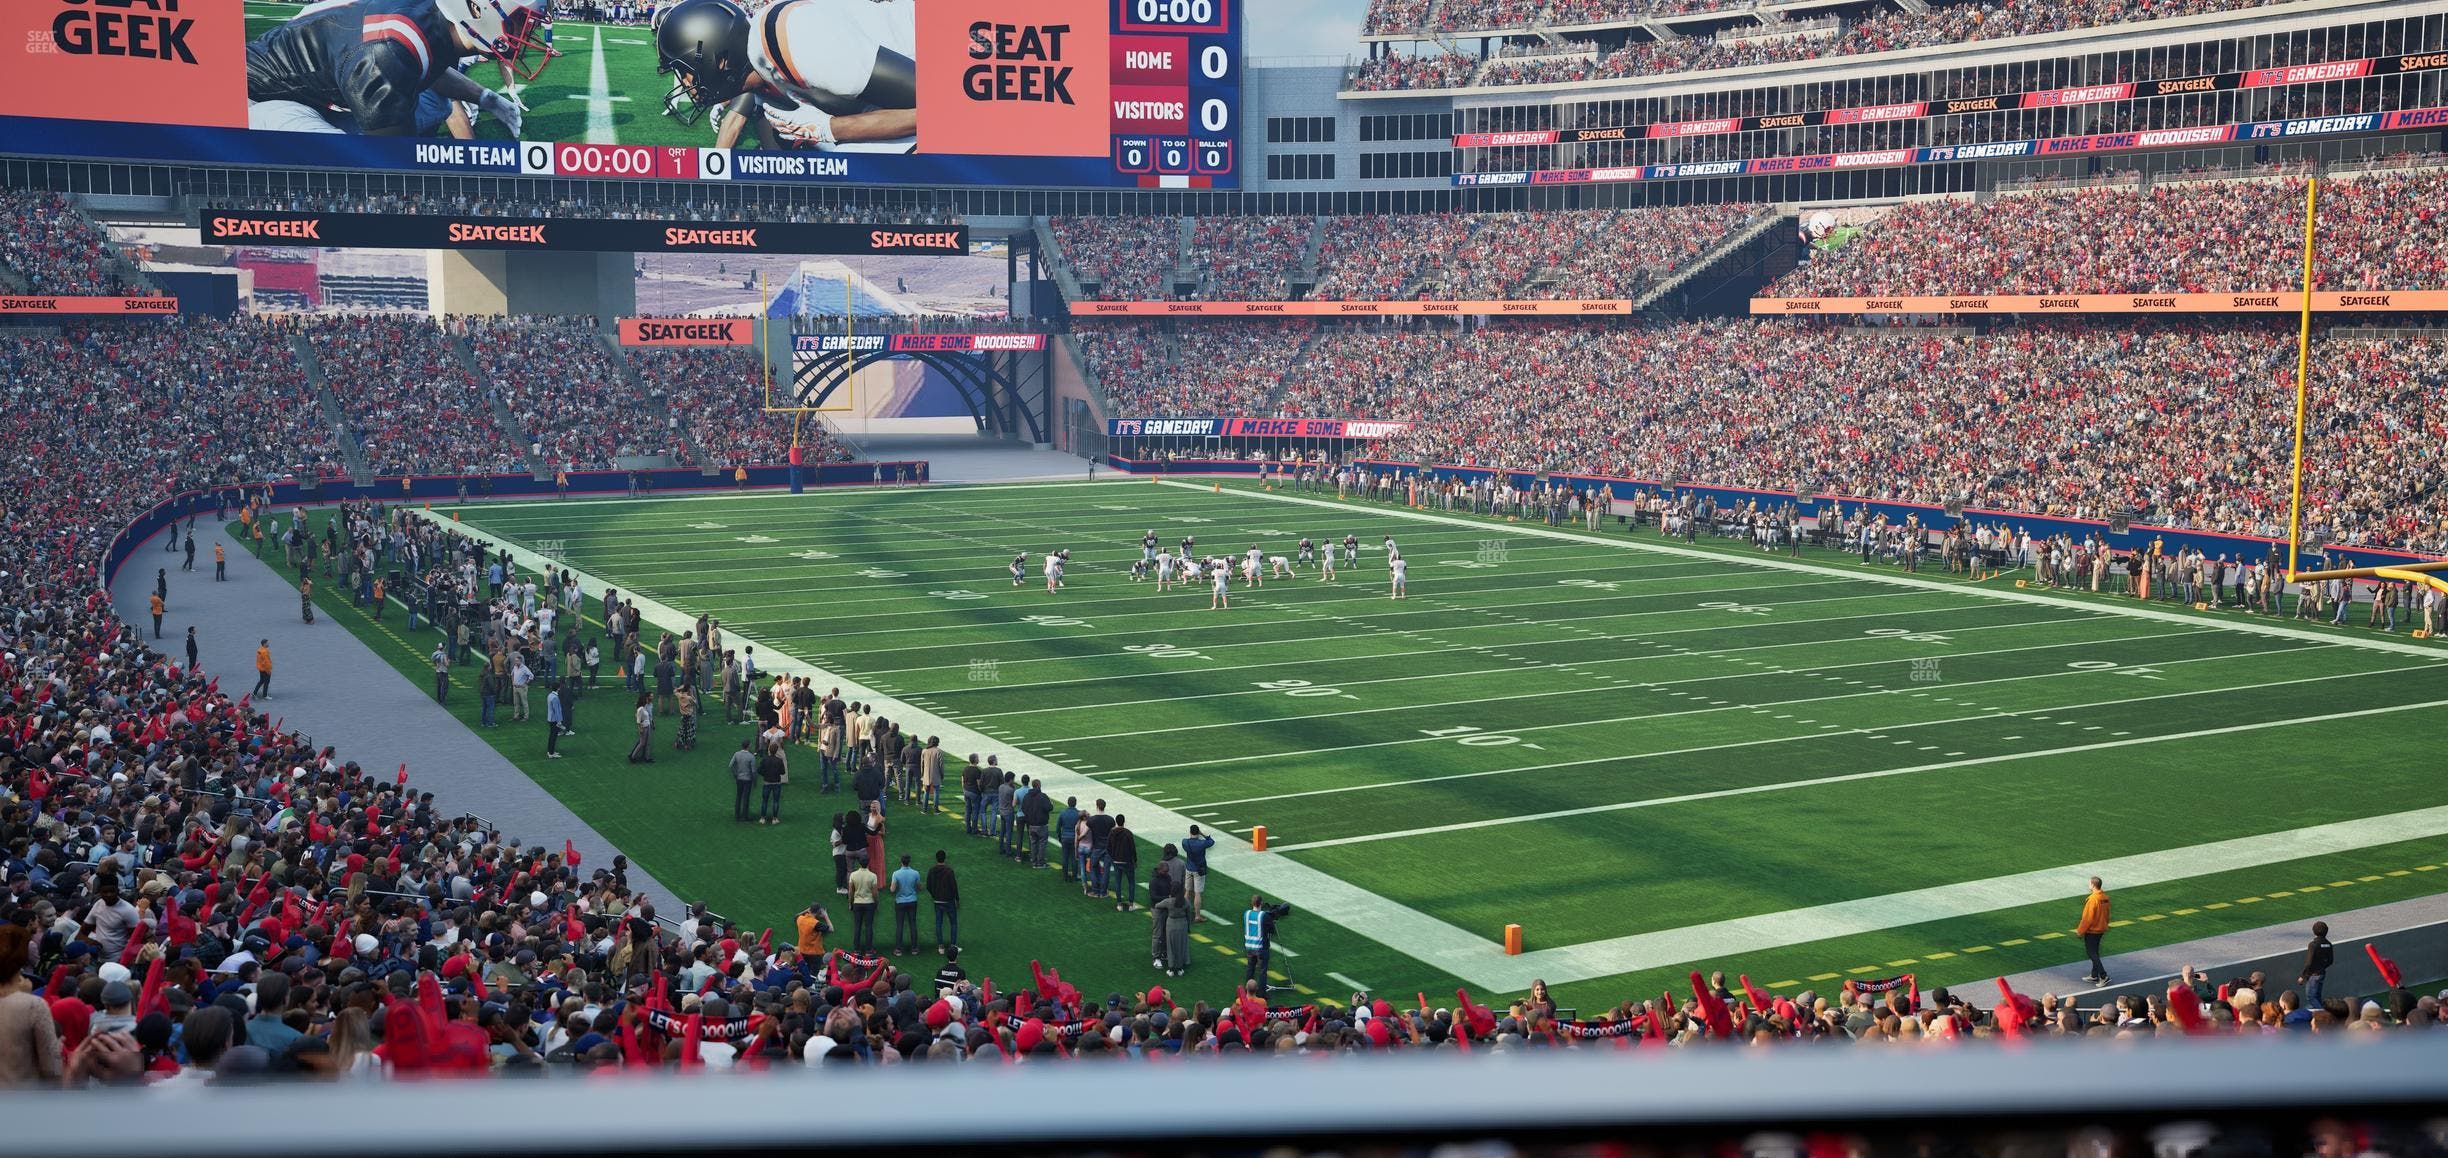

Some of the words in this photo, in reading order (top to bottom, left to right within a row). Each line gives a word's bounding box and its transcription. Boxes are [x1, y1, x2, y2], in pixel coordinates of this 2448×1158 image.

[52, 10, 199, 65] GEEK
[968, 21, 1071, 61] SEAT
[1126, 51, 1172, 70] HOME
[1201, 46, 1228, 79] 0
[2258, 71, 2284, 84] IT'S
[2287, 62, 2359, 81] GAMEDAY!
[963, 64, 1075, 105] GEEK
[2158, 77, 2215, 94] SEATGEEK
[2036, 91, 2059, 105] IT'S
[2062, 82, 2123, 102] GAMEDAY!
[1114, 101, 1184, 121] VISITORS
[1947, 98, 1997, 113] SEATGEEK
[1201, 98, 1228, 131] 0
[1760, 114, 1805, 129] SEATGEEK
[1838, 110, 1858, 122] IT'S
[1861, 106, 1917, 120] GAMEDAY!
[1578, 127, 1625, 141] SEATGEEK
[1659, 124, 1677, 135] IT'S
[1680, 121, 1731, 134] GAMEDAY!
[2251, 121, 2281, 138] IT'S
[2285, 116, 2371, 135] GAMEDAY!
[1469, 135, 1489, 145] IT'S
[1492, 132, 1549, 144] GAMEDAY!
[2048, 138, 2091, 152] MAKE
[2095, 134, 2136, 149] SOME
[416, 144, 465, 164] HOME
[469, 146, 516, 166] TEAM
[527, 146, 548, 169] 0
[668, 147, 687, 157] QRT
[1127, 149, 1142, 166] 0
[1167, 150, 1181, 166] 0
[1206, 150, 1220, 167] 0
[1928, 148, 1954, 160] IT'S
[1956, 143, 2027, 158] GAMEDAY!
[560, 148, 651, 174] 00:00
[673, 159, 682, 174] 1
[706, 152, 724, 175] 0
[738, 155, 805, 174] VISITORS
[808, 157, 848, 175] TEAM
[1758, 158, 1794, 171] MAKE
[1798, 155, 1832, 168] SOME
[1540, 172, 1566, 182] MAKE
[1568, 170, 1590, 181] SOME
[1654, 165, 1677, 178] IT'S
[1679, 162, 1740, 176] GAMEDAY!
[1459, 174, 1476, 185] IT'S
[1478, 172, 1526, 184] GAMEDAY!
[213, 217, 320, 239] SEATGEEK
[449, 223, 546, 244] SEATGEEK
[665, 228, 757, 247] SEATGEEK
[871, 230, 960, 249] SEATGEEK
[2, 299, 57, 310] SEATGEEK
[125, 300, 176, 310] SEATGEEK
[1096, 304, 1128, 312] SEATGEEK
[1168, 304, 1201, 312] SEATGEEK
[1246, 304, 1283, 312] SEATGEEK
[1341, 304, 1378, 312] SEATGEEK
[1423, 304, 1459, 312] SEATGEEK
[1503, 304, 1537, 312] SEATGEEK
[1581, 304, 1617, 312] SEATGEEK
[1786, 300, 1820, 310] SEATGEEK
[1866, 300, 1903, 310] SEATGEEK
[1950, 299, 1988, 309] SEATGEEK
[2039, 299, 2080, 308] SEATGEEK
[2132, 298, 2176, 308] SEATGEEK
[2233, 297, 2279, 307] SEATGEEK
[2340, 295, 2390, 307] SEATGEEK
[638, 322, 734, 342] SEATGEEK
[797, 336, 819, 350] IT'S
[822, 336, 884, 350] GAMEDAY!
[902, 337, 934, 349] MAKE
[940, 337, 971, 349] SOME
[1116, 420, 1141, 434] IT'S
[1145, 420, 1213, 434] GAMEDAY!
[1241, 422, 1298, 434] MAKE
[1306, 422, 1342, 435] SOME
[1857, 981, 1871, 991] LET'S
[650, 1010, 683, 1034] LET'S
